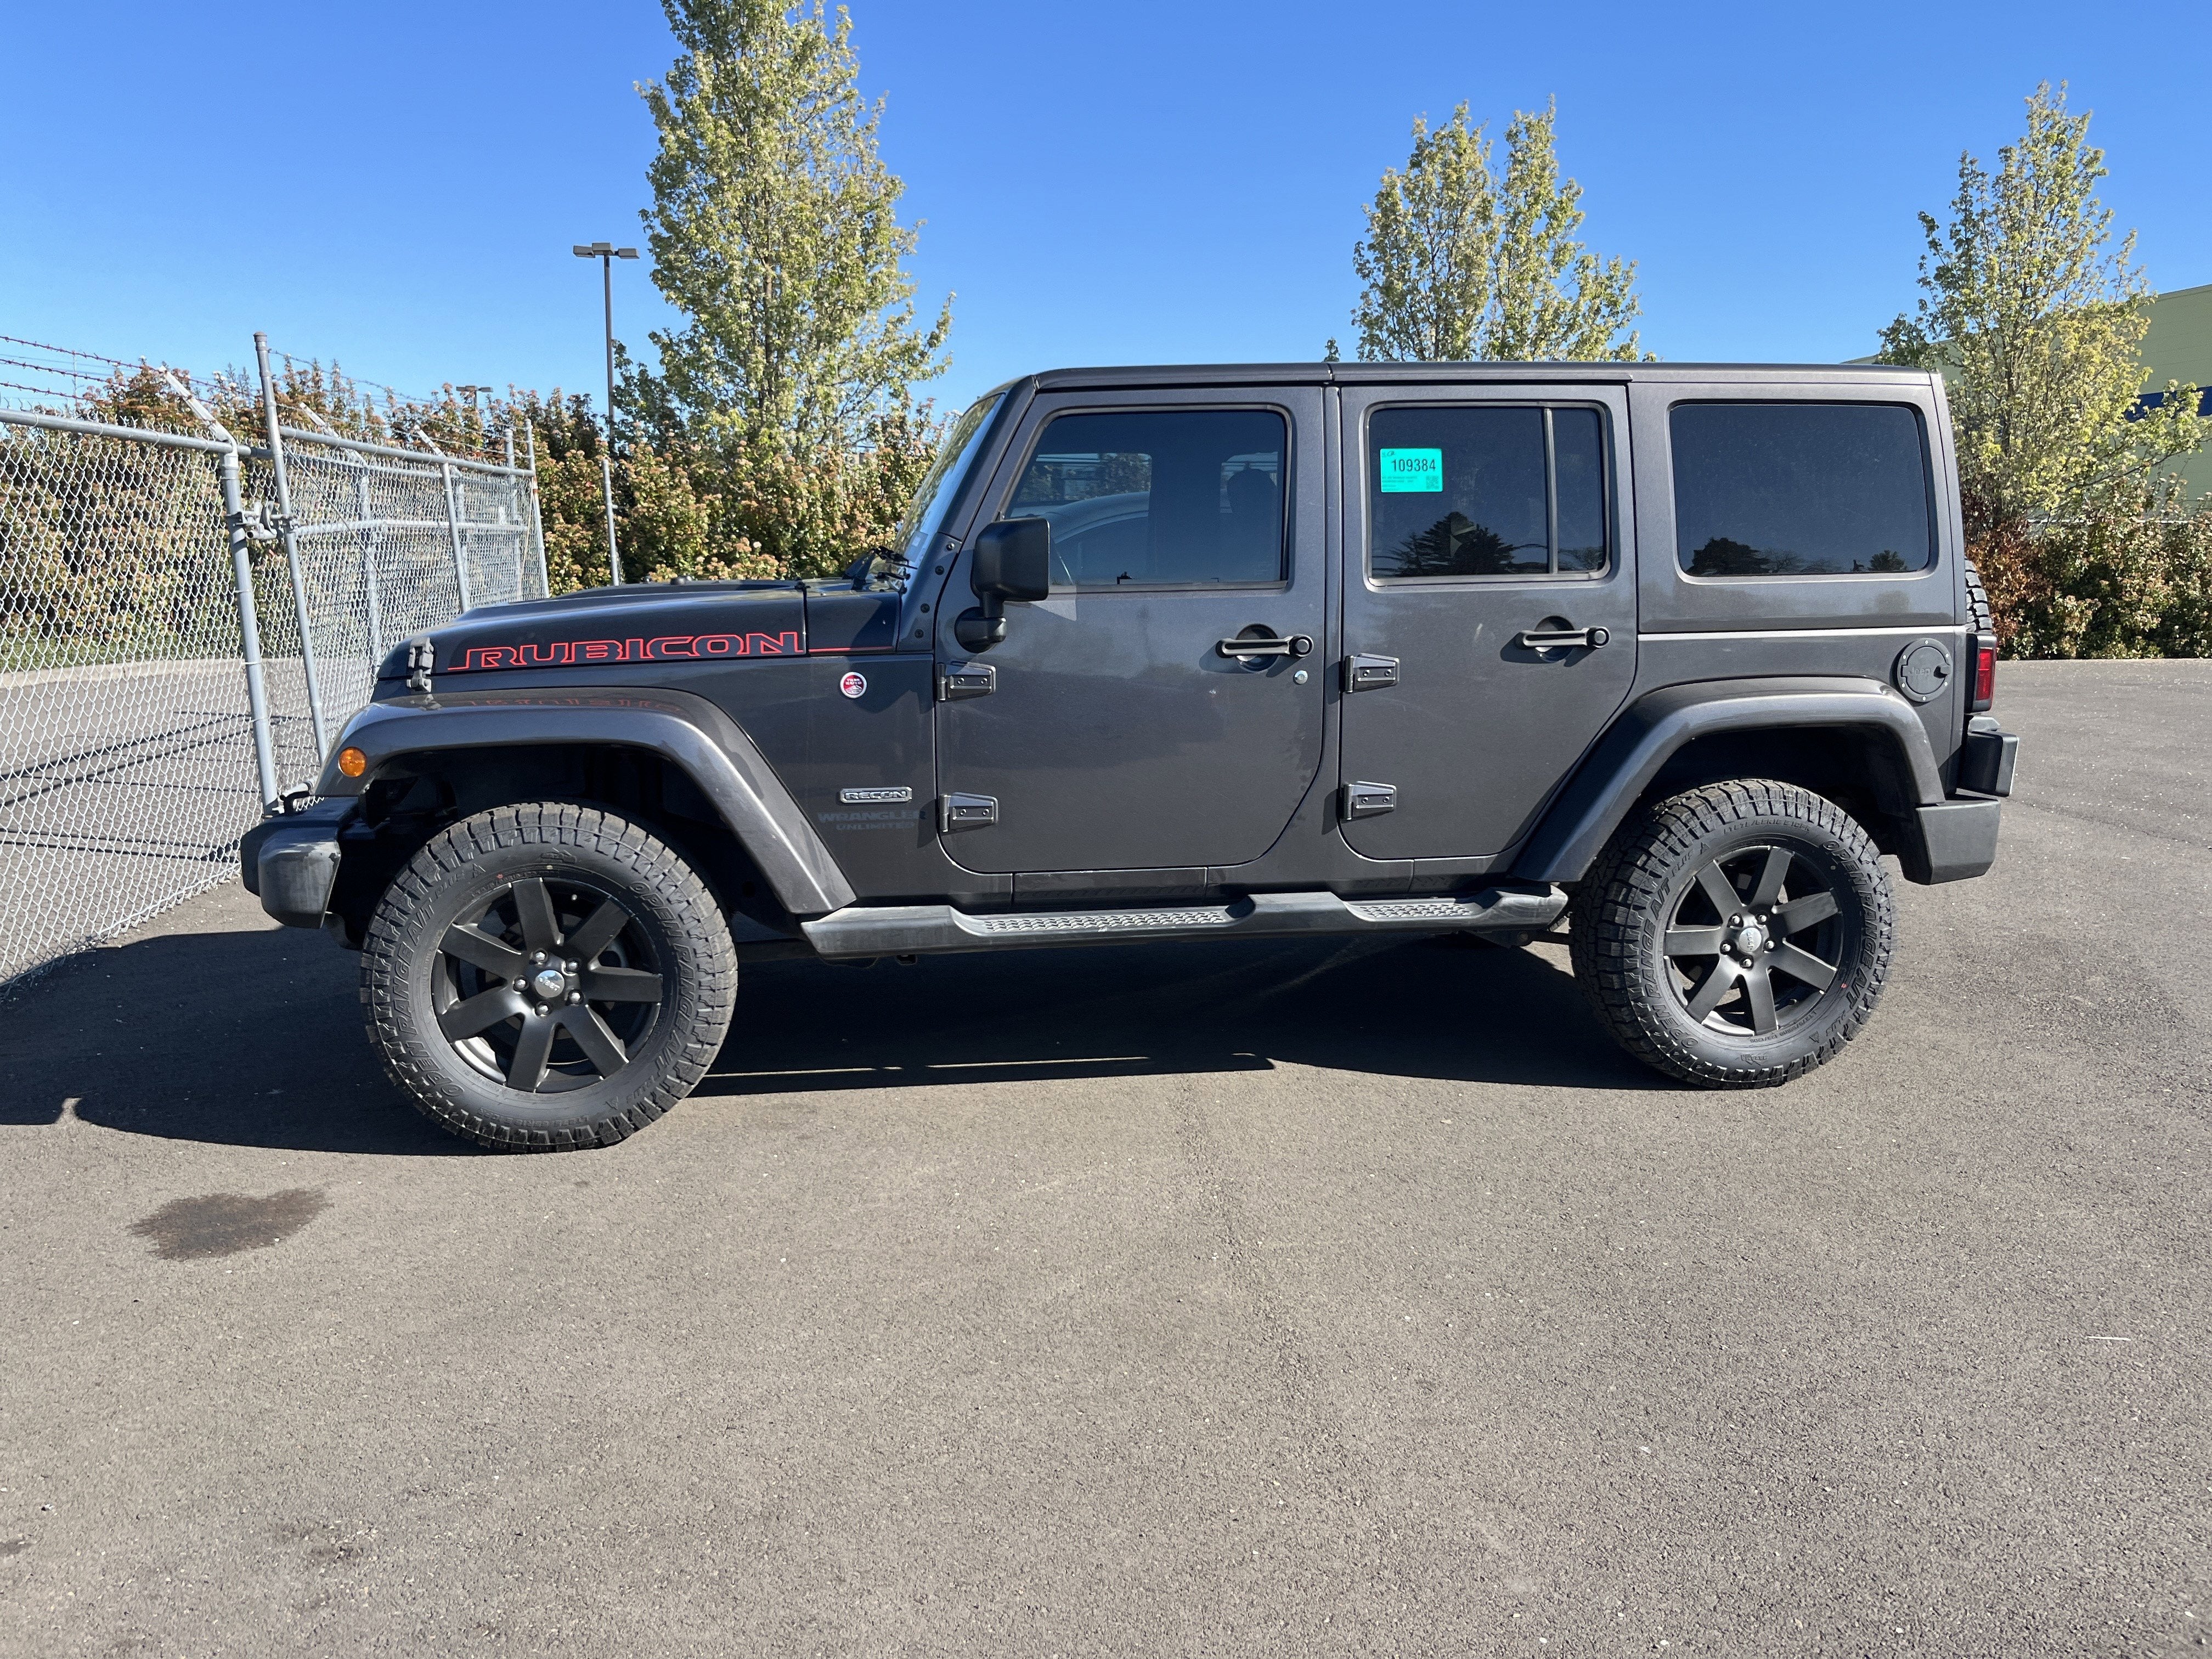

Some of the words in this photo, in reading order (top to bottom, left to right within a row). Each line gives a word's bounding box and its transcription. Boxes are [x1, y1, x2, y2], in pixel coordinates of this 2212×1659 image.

[1391, 459, 1436, 472] 109384
[448, 631, 804, 670] RUBICON
[1909, 667, 1931, 676] Jeep
[817, 809, 927, 822] WRANGLER
[845, 791, 906, 800] RECON
[836, 822, 915, 830] UNLIMITED
[1822, 840, 1867, 884] OPEN
[1651, 877, 1671, 920] A/T
[408, 898, 435, 946] A/T
[1858, 890, 1877, 969] RANGE
[629, 881, 685, 938] OPEN
[673, 943, 696, 1035] RANGE
[1641, 918, 1662, 998] RANGE
[393, 941, 419, 1035] RANGE
[1846, 967, 1867, 1009] A/T
[1652, 1005, 1699, 1048] OPEN
[407, 1041, 465, 1097] OPEN
